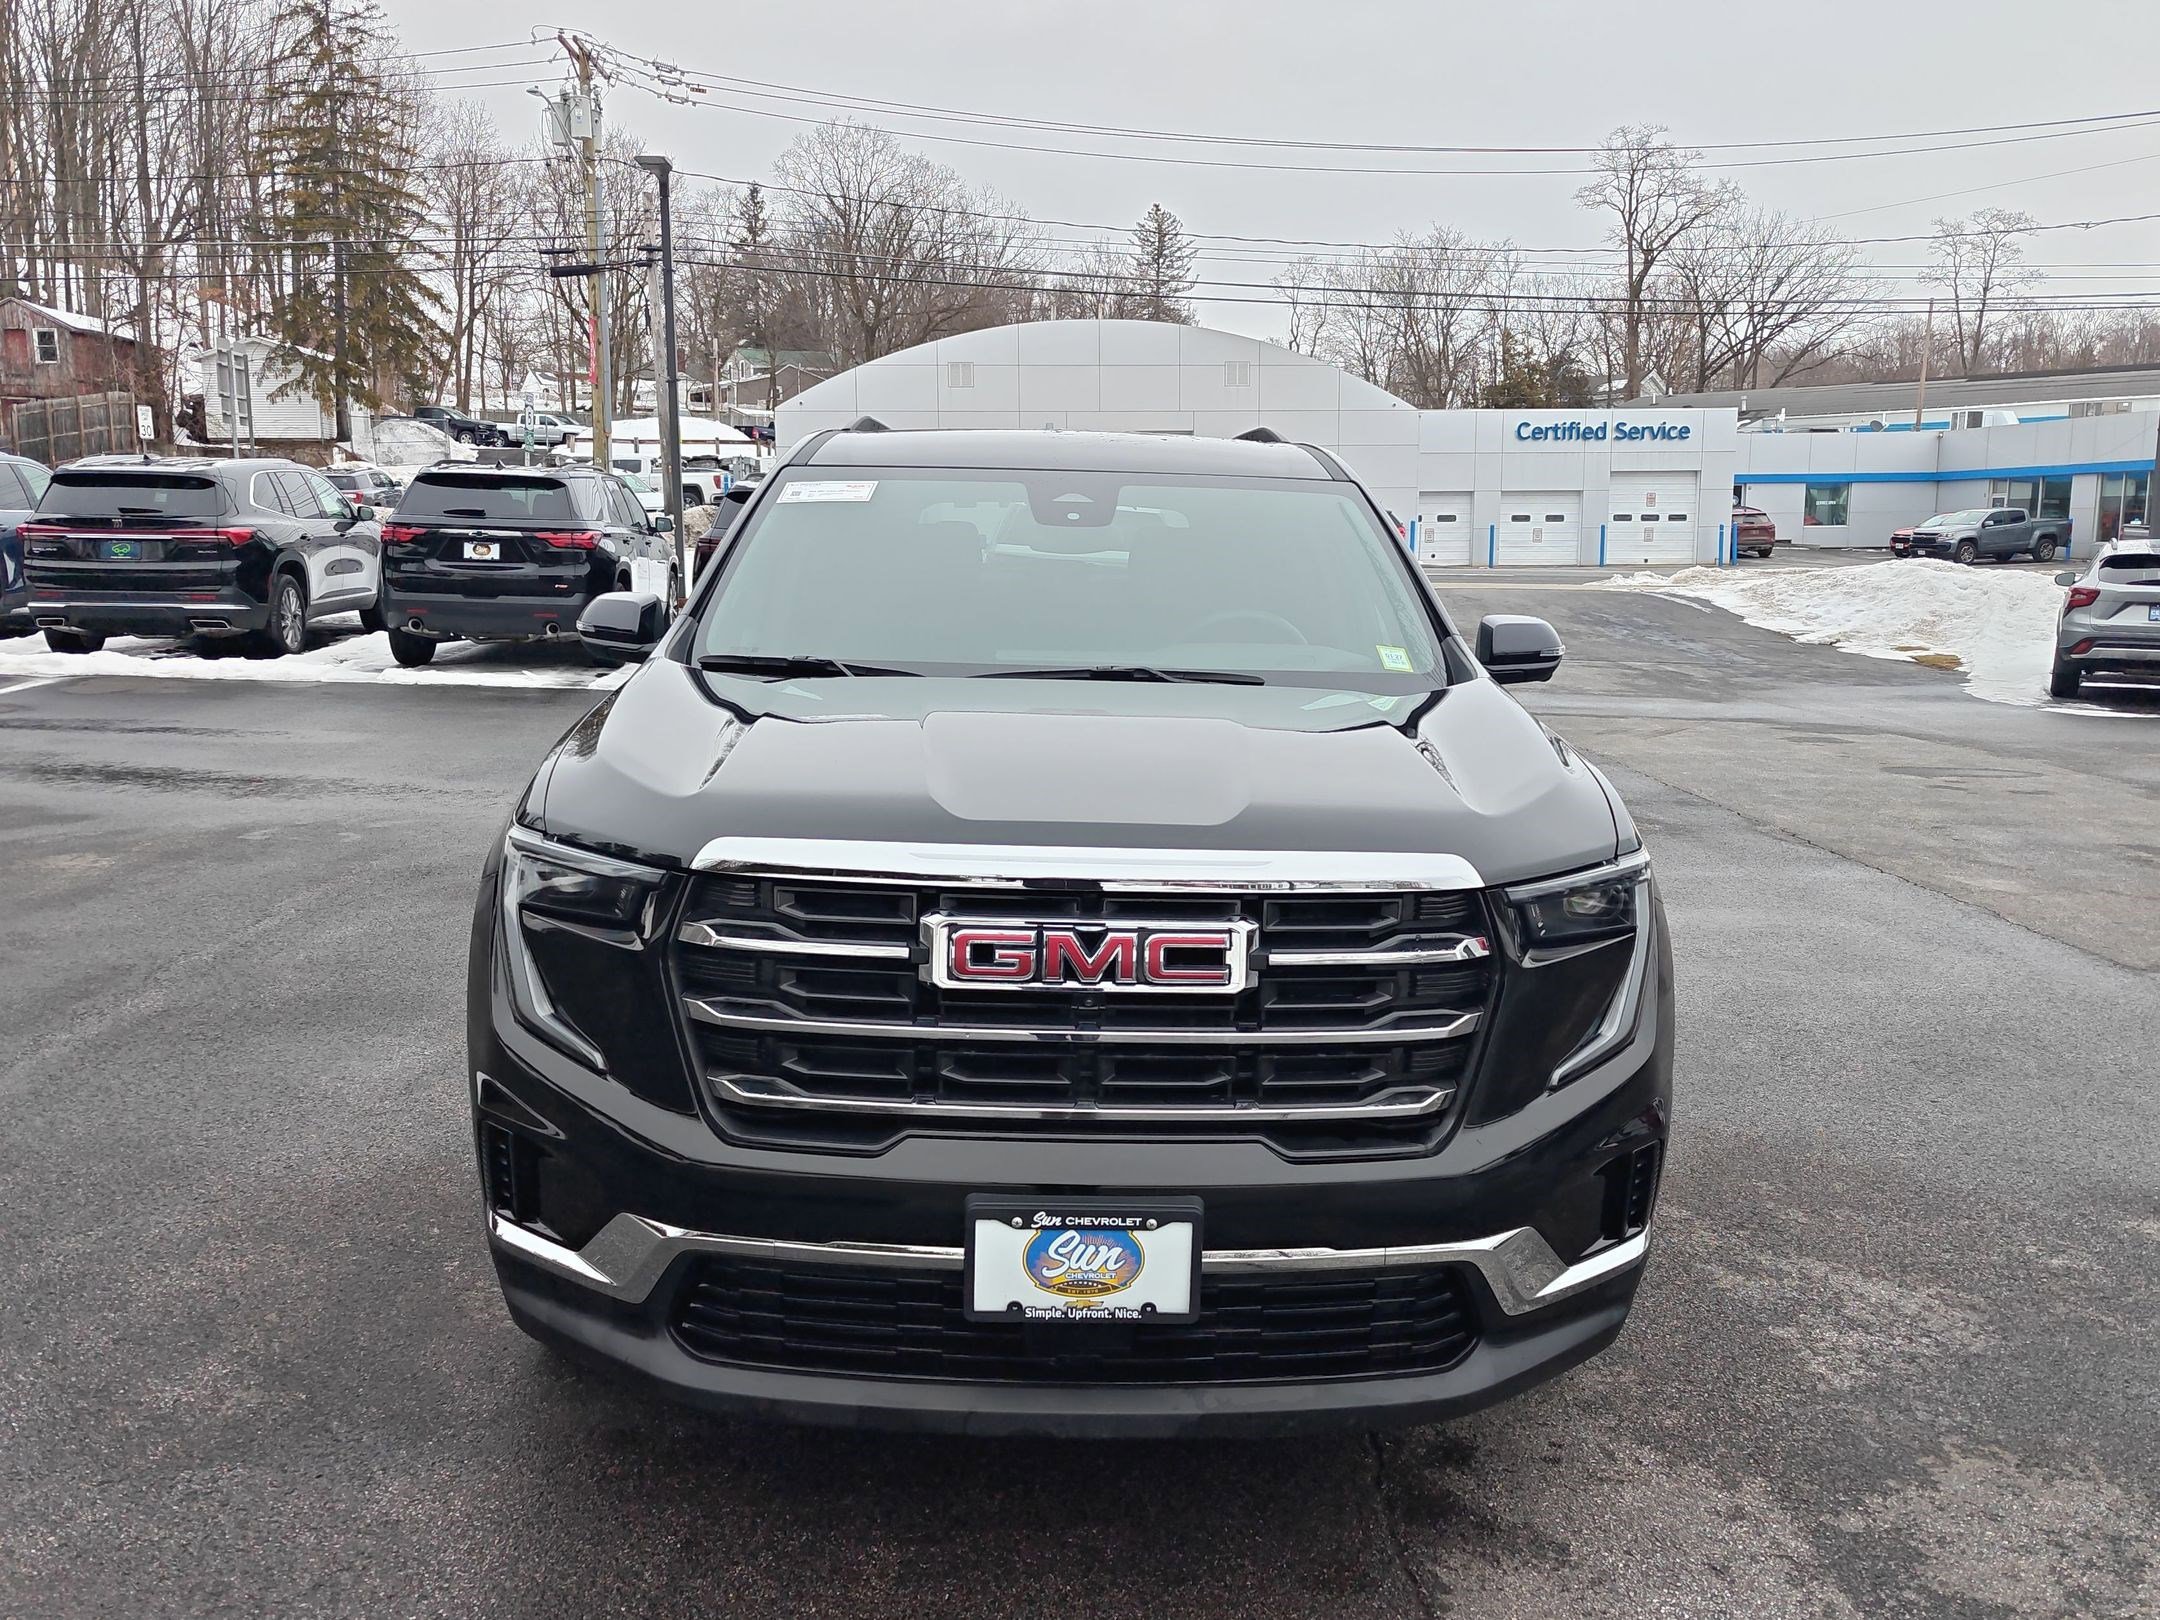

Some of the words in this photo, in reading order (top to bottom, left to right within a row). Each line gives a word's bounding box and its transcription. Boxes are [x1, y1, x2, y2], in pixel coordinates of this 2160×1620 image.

[141, 424, 152, 437] 30
[1516, 421, 1608, 441] Certified
[1613, 421, 1691, 441] Service
[951, 929, 1232, 985] GMC
[1031, 1211, 1063, 1229] Sun
[1065, 1217, 1143, 1227] CHEVROLET
[1042, 1229, 1126, 1278] Sun
[1065, 1272, 1117, 1280] CHEVROLET
[1025, 1307, 1065, 1321] Simple.
[1067, 1307, 1113, 1321] Upfront.
[1114, 1308, 1143, 1319] Nice.
